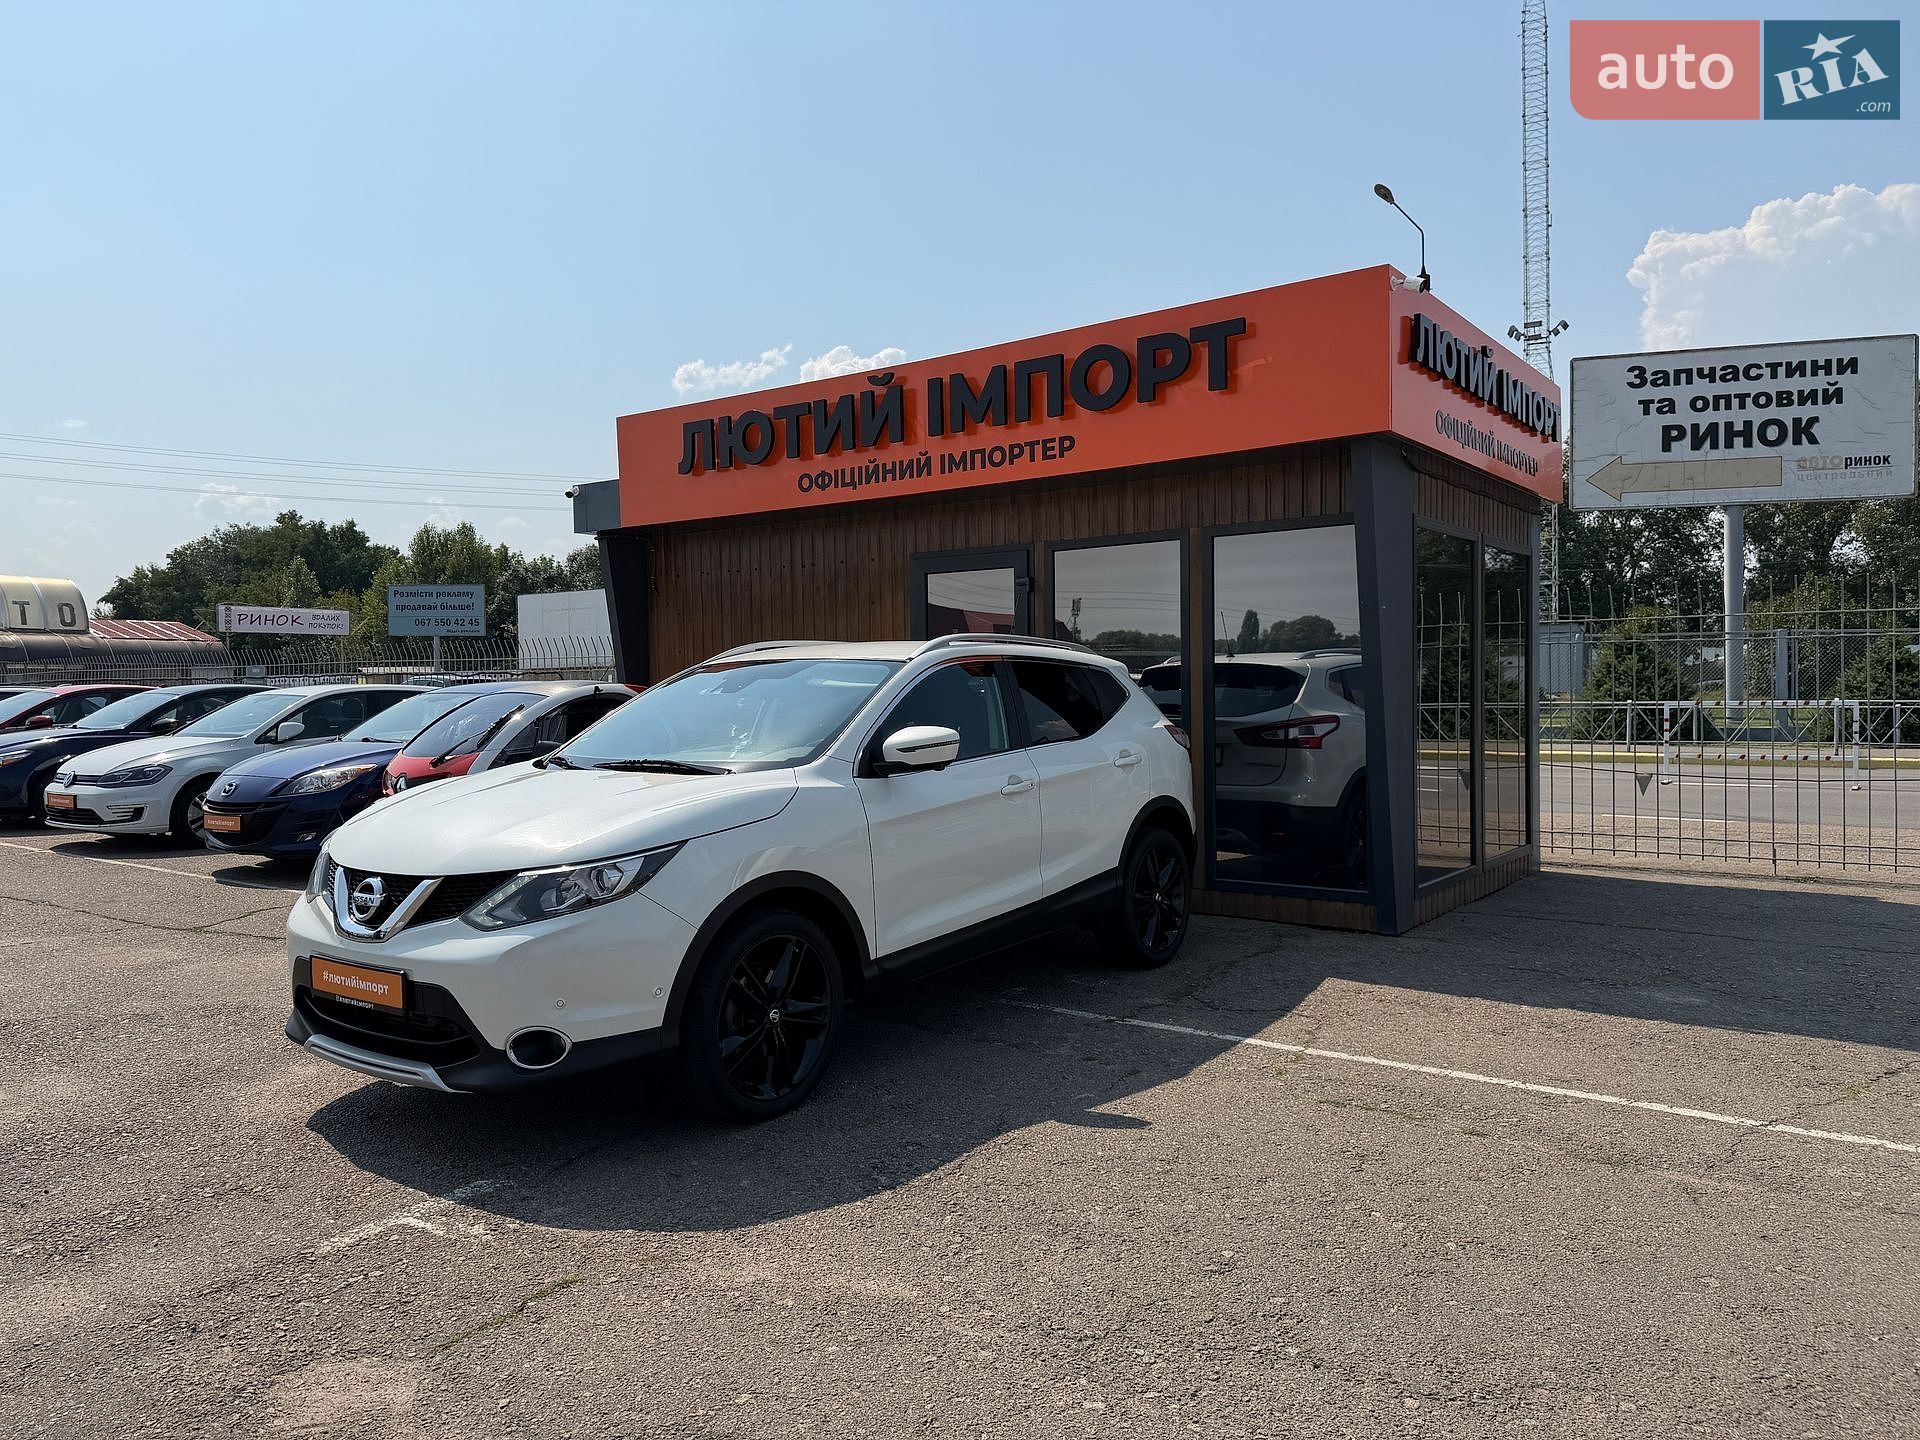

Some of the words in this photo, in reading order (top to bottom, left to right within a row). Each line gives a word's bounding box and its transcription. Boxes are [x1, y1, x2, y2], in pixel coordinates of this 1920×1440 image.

[1413, 313, 1497, 406] ЛЮТИЙ
[1497, 368, 1561, 443] ІМПОРТ
[1626, 356, 1859, 389] Запчастини
[677, 372, 904, 475] ЛЮТИЙ
[927, 317, 1247, 437] ІМПОРТ
[1638, 397, 1676, 416] та
[1689, 381, 1844, 414] оптовий
[1435, 409, 1496, 459] ОФІЦІЙНИЙ
[1661, 415, 1821, 453] РИНОК
[797, 451, 933, 493] ОФІЦІЙНИЙ
[939, 435, 1077, 474] ІМПОРТЕР
[393, 589, 434, 598] Розмісти
[436, 591, 475, 599] рекламу
[395, 602, 438, 612] продавай
[440, 602, 475, 611] більше!
[237, 613, 304, 626] РИНОК
[414, 618, 432, 627] 067
[434, 618, 452, 627] 550
[453, 618, 466, 627] 42
[468, 618, 480, 627] 45
[353, 894, 375, 905] SSAN
[323, 970, 389, 995] #лютийімпорт
